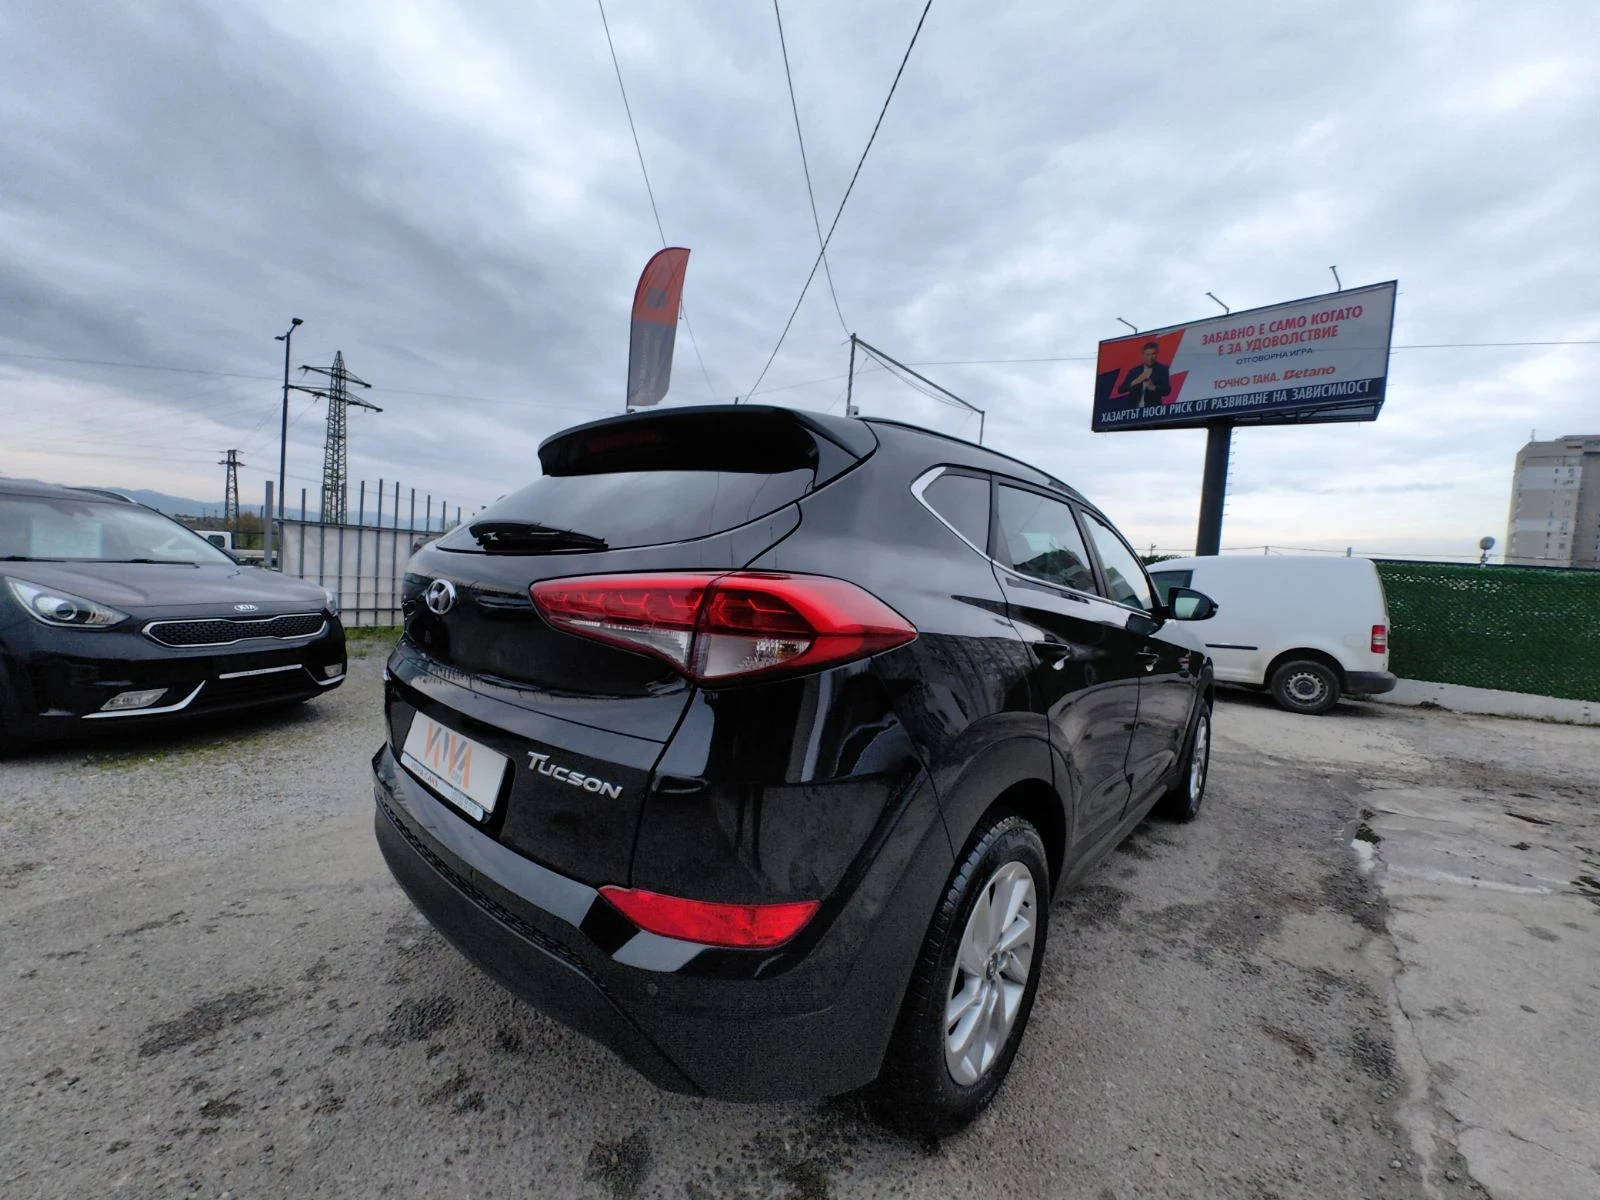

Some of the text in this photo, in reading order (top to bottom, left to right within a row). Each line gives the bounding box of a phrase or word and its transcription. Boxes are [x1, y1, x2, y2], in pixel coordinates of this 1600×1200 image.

[1202, 305, 1364, 346] ЗАБАВНО Е САМО КОГАТО
[1218, 325, 1338, 356] Е ЗА УДОВОЛСТВИЕ
[1236, 347, 1313, 365] ОТГОВОРНА ИГРА
[1213, 366, 1336, 390] ТОЧНО ТАКА. Betano
[1101, 379, 1373, 423] ХАЗАРТЪТ НОСИ РИСК ОТ РАЗВИВАНЕ НА ЗАВИСИМОСТ
